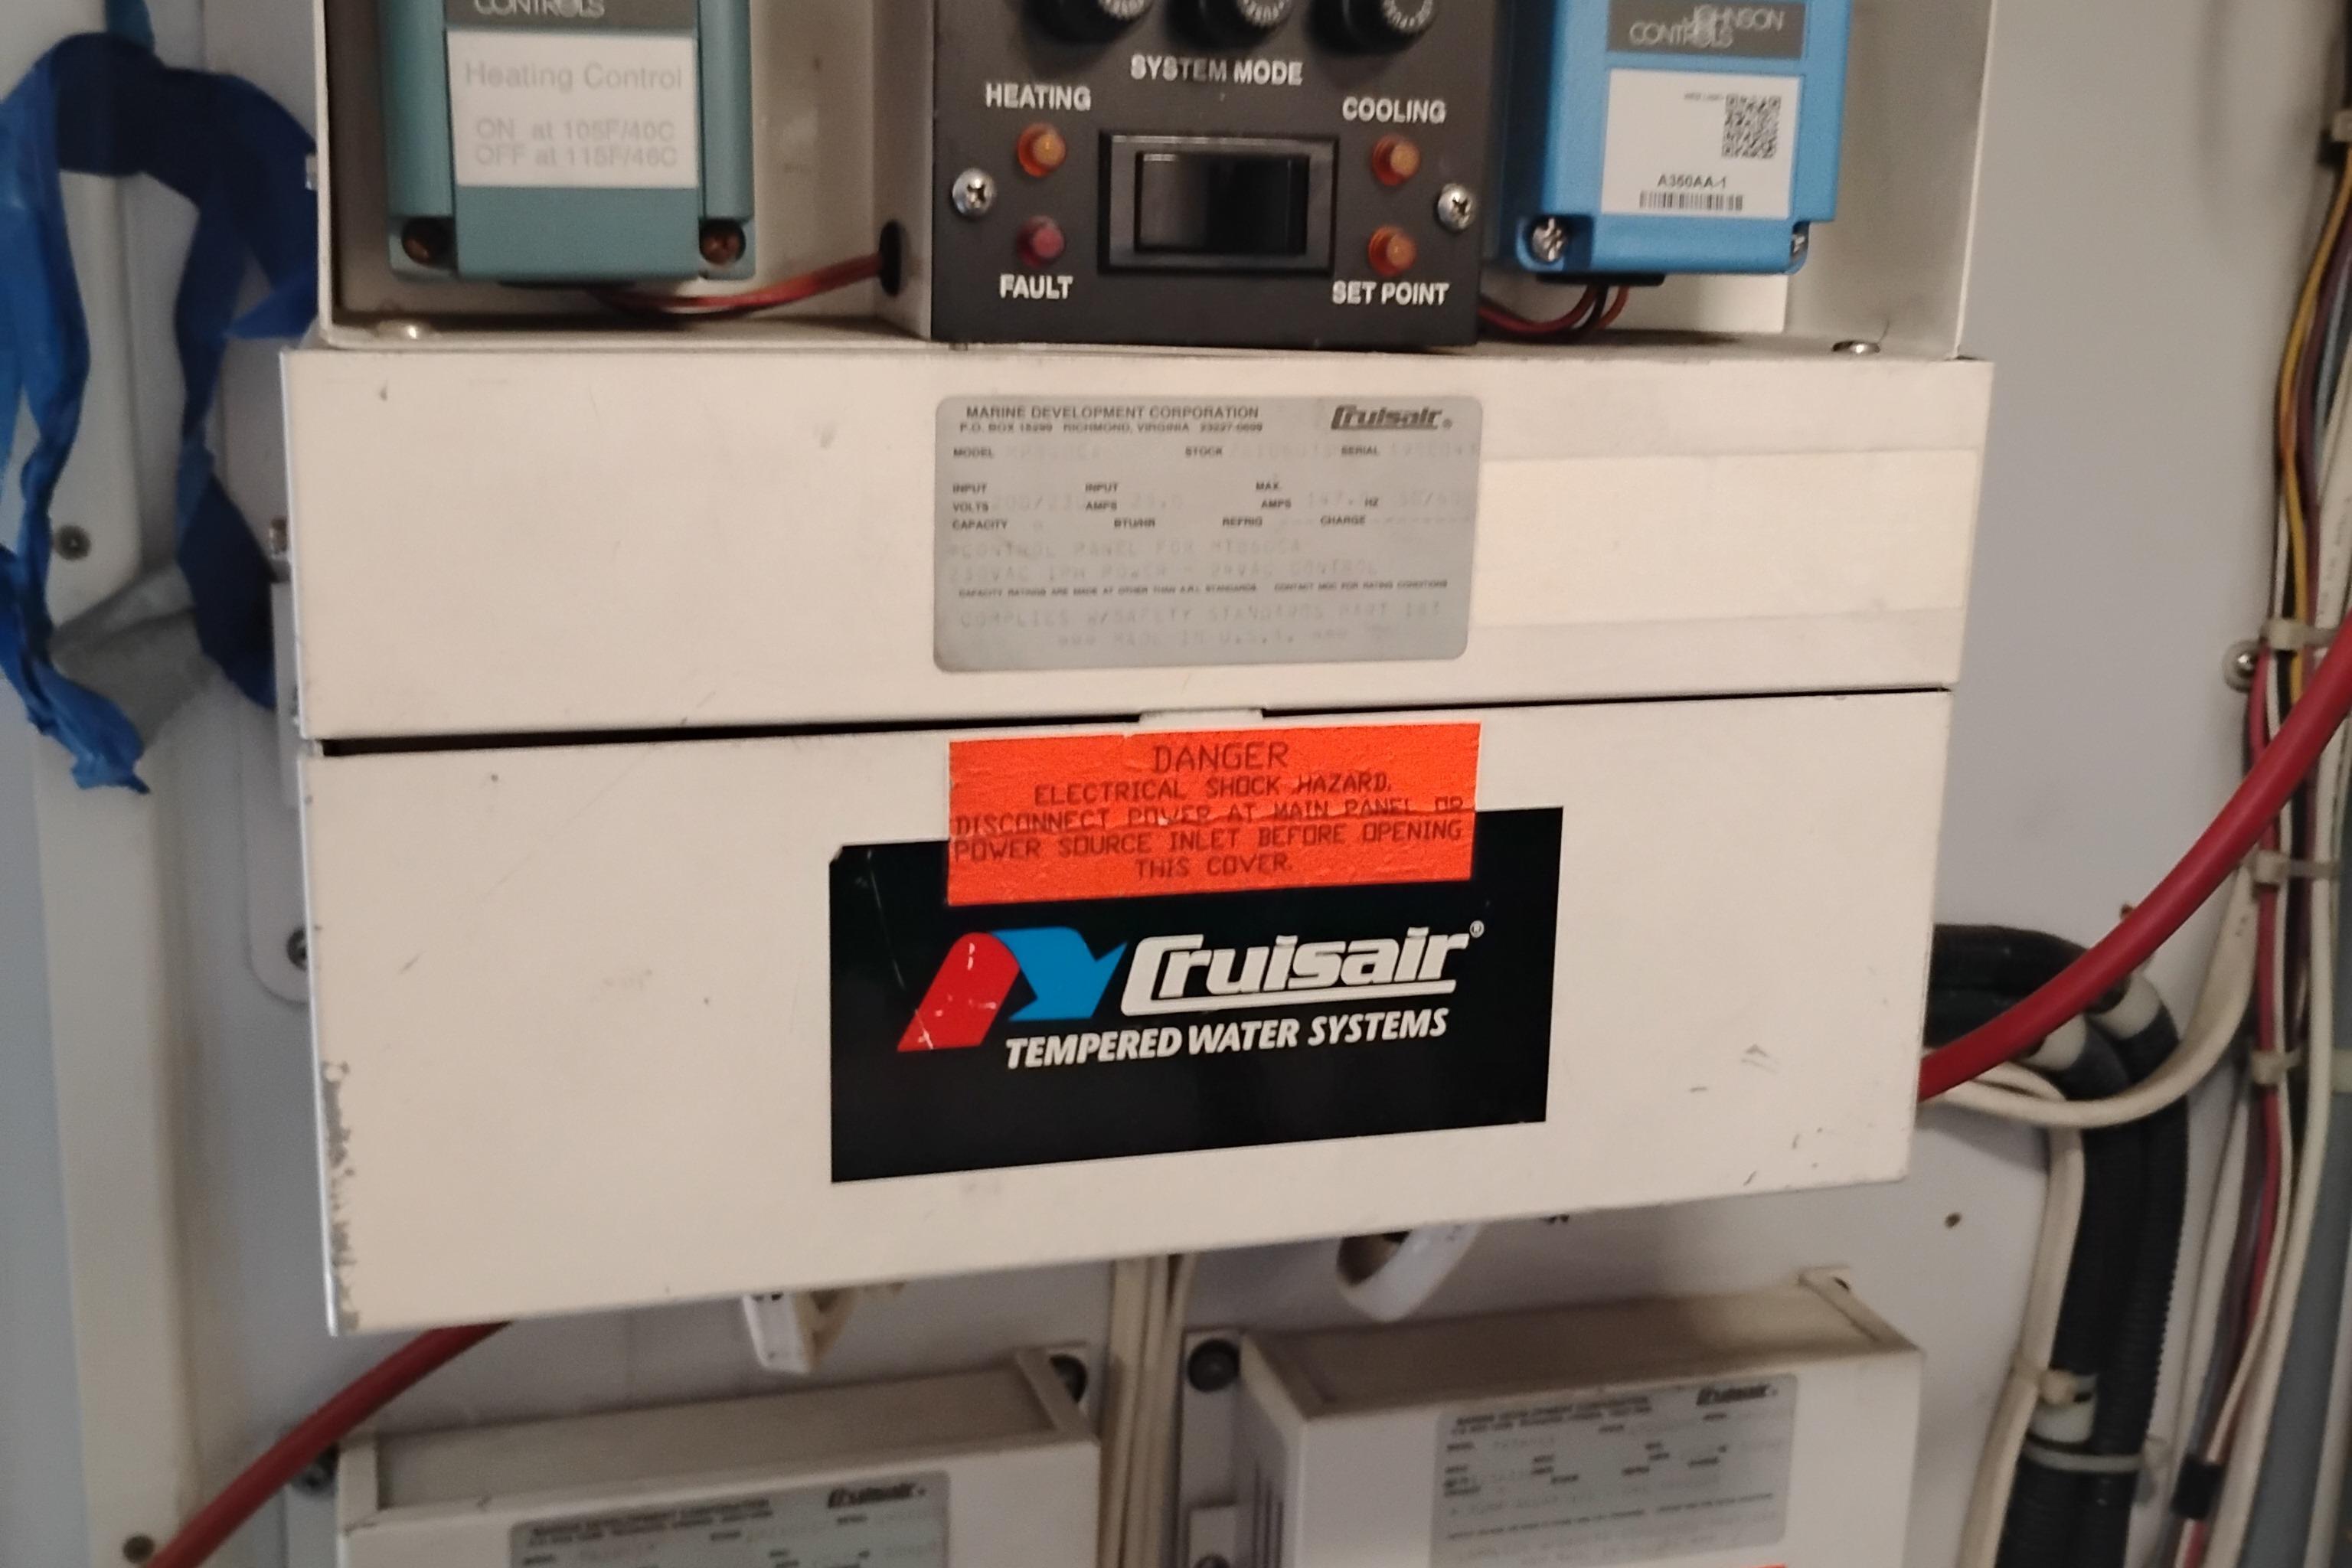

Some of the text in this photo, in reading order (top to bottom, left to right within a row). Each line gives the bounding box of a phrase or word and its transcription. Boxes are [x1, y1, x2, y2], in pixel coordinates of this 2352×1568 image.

[465, 60, 682, 93] Heating Control
[1130, 54, 1303, 87] SYSTEM MODE
[985, 82, 1092, 112] HEATING
[1342, 96, 1447, 124] COOLING
[476, 117, 515, 140] ON
[532, 120, 554, 140] at
[476, 142, 526, 165] OFF
[535, 145, 557, 166] at
[1657, 174, 1727, 188] A350AA-1
[999, 274, 1073, 300] FAULT
[1332, 280, 1450, 306] SET POINT
[966, 406, 1259, 420] MARINE DEVELOPMENT CORPORATION
[988, 423, 1014, 433] BOX
[1137, 423, 1190, 433] VIRGINIA
[953, 446, 993, 457] MODEL
[1341, 445, 1379, 456] SERIAL
[952, 483, 988, 494] INPUT
[1085, 482, 1119, 493] INPUT
[952, 502, 988, 512] VOLTS
[1086, 500, 1117, 511] AMPS
[1261, 498, 1292, 509] AMPS
[952, 520, 1008, 531] CAPACITY
[1321, 515, 1366, 526] CHARGE
[1152, 740, 1289, 773] DANGER
[1034, 779, 1187, 805] ELECTRICAL
[1205, 775, 1279, 799] SHOCK
[954, 795, 1465, 837] DISCONNECT POWER AT MAIN PANEL OR
[955, 820, 1463, 863] POWER SOURCE INLET BEFORE OPENING
[1135, 856, 1190, 880] THIS
[1120, 926, 1471, 1017] Cruisair
[1005, 1008, 1449, 1070] TEMPERED WATER SYSTEMS
